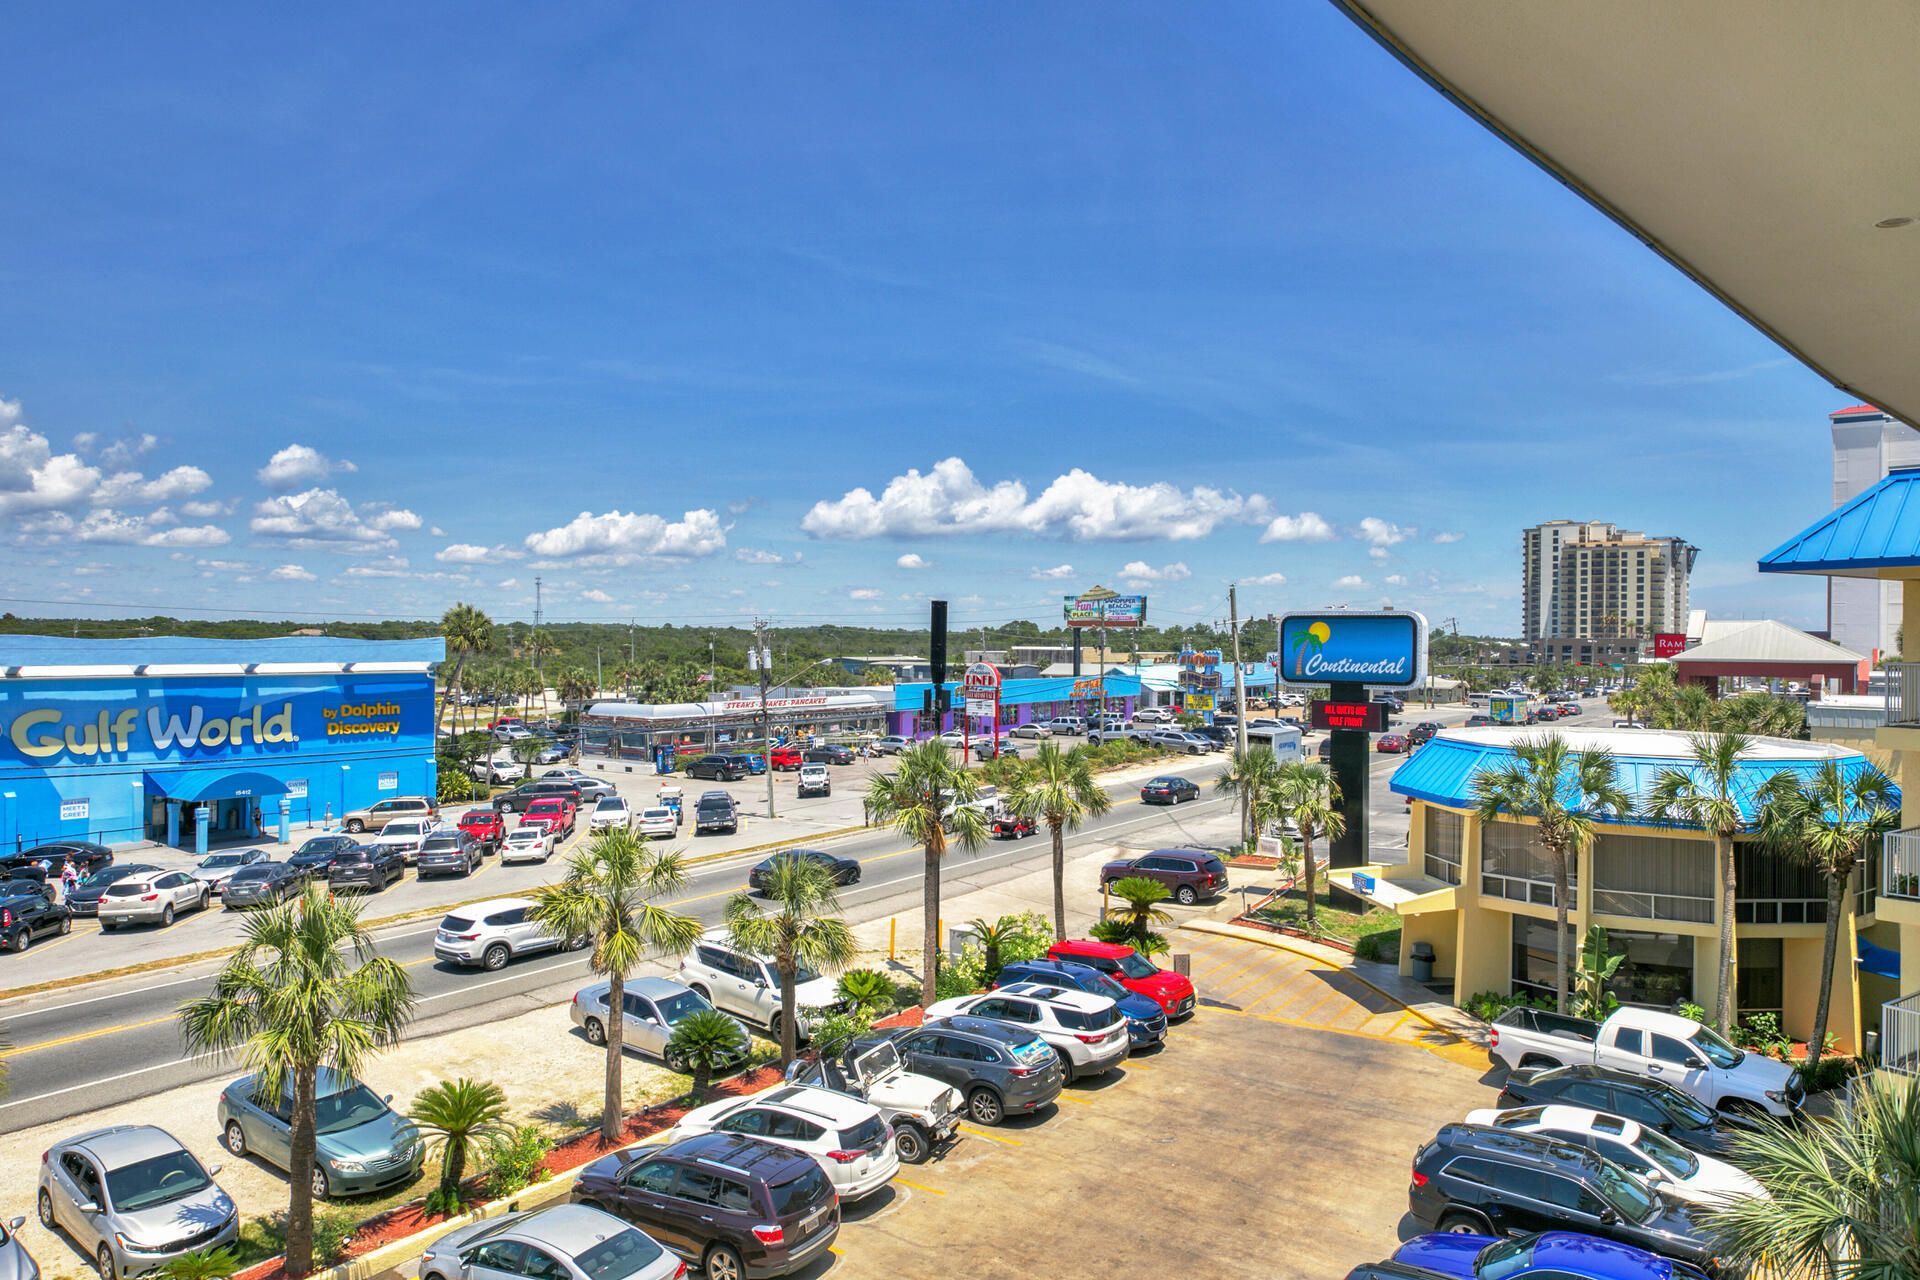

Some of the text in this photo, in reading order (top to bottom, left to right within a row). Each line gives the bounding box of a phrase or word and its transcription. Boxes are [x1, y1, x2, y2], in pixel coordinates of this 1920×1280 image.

[1658, 639, 1684, 648] RAM
[1305, 653, 1405, 676] Continental
[322, 702, 400, 719] by Dolphin
[726, 701, 755, 709] STEAKS
[790, 698, 827, 706] PANCAKES
[11, 702, 293, 757] Gulf World
[327, 721, 400, 735] Discovery
